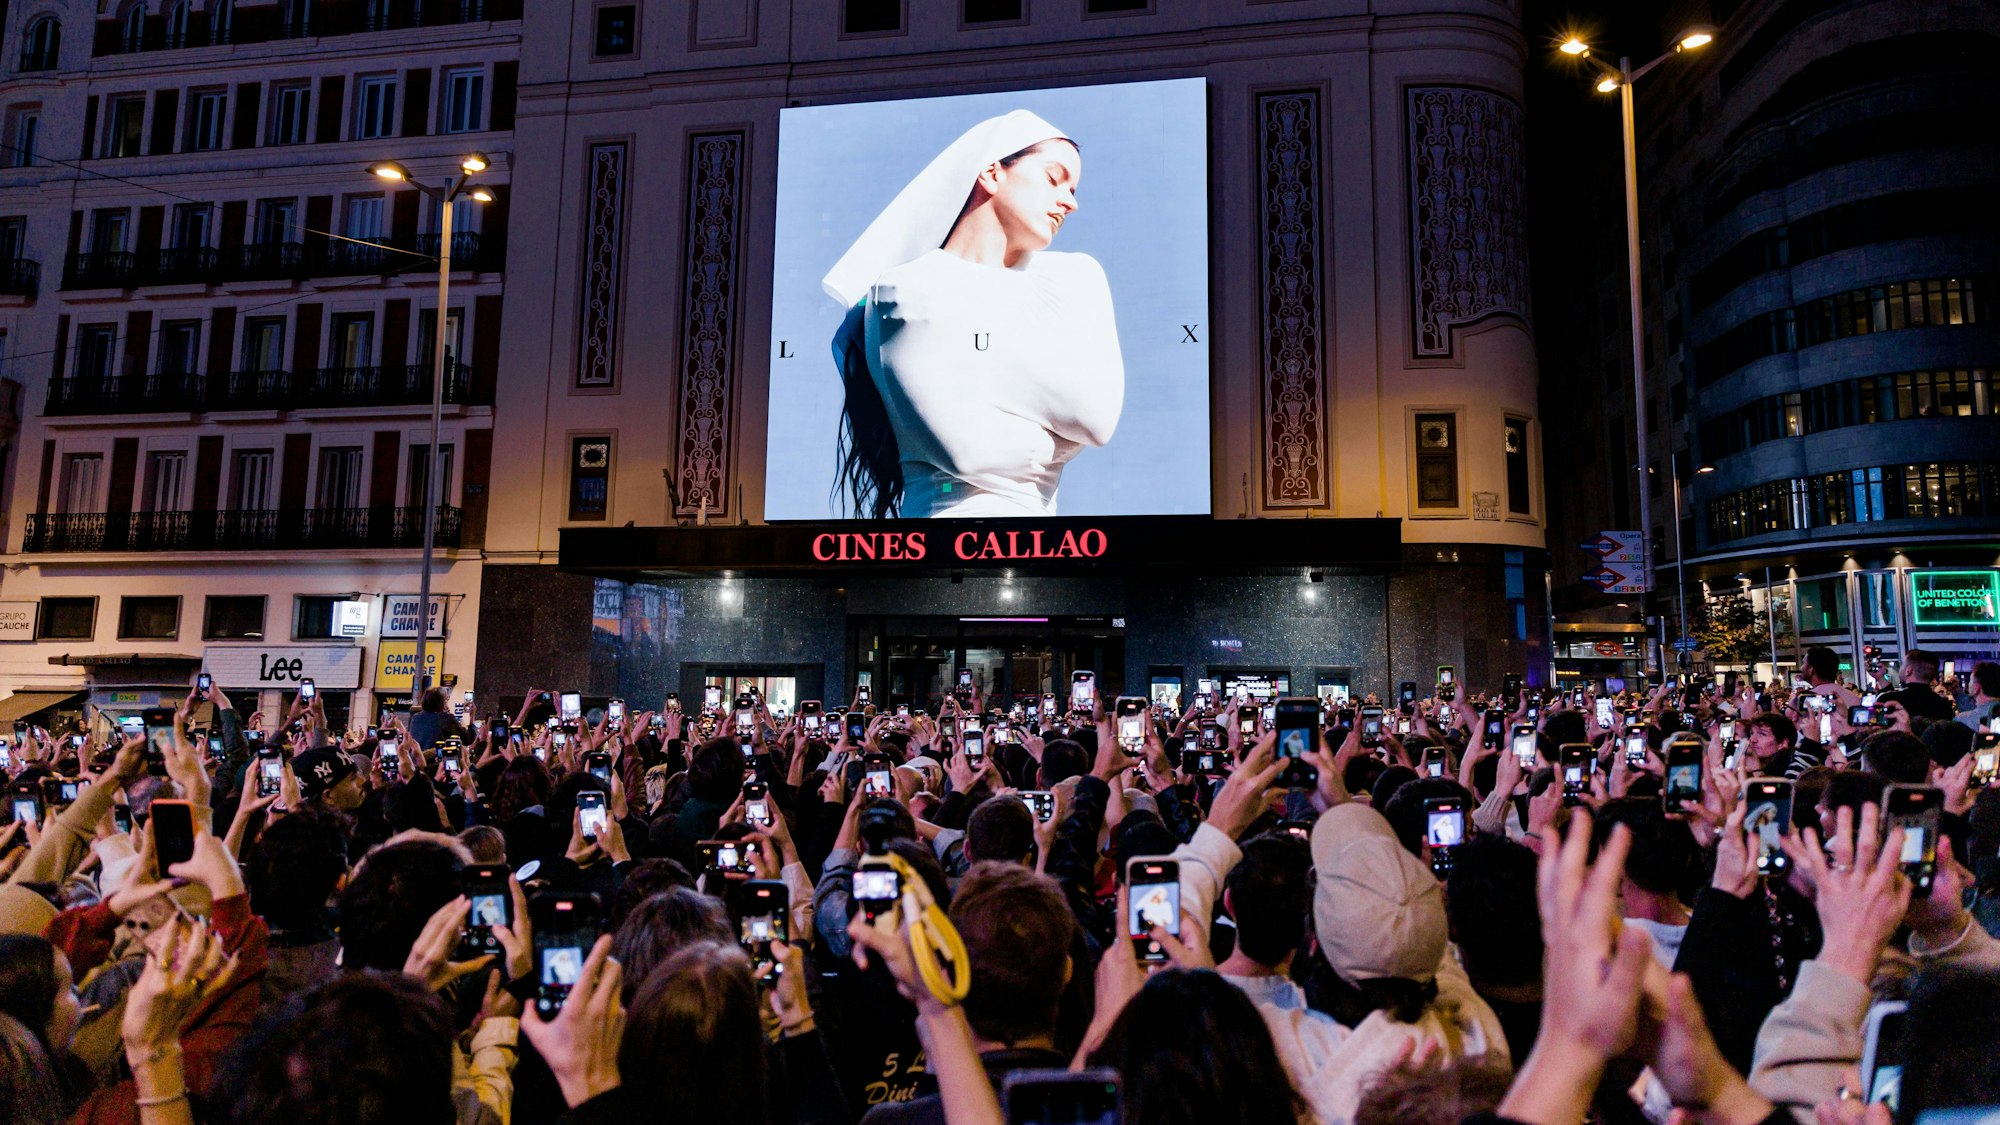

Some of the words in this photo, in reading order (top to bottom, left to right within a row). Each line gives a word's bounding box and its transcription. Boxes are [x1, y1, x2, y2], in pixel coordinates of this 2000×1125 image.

[778, 340, 795, 358] L
[973, 333, 990, 351] U
[1180, 324, 1199, 344] X
[812, 532, 927, 561] CINES
[954, 528, 1108, 560] CALLAO
[1917, 589, 1955, 598] UNITED
[1957, 588, 1997, 598] COLORS
[393, 602, 438, 615] CAMO
[1918, 599, 1933, 607] OF
[0, 612, 26, 620] GRUPO
[391, 617, 436, 630] CHANE
[259, 653, 303, 682] Lee
